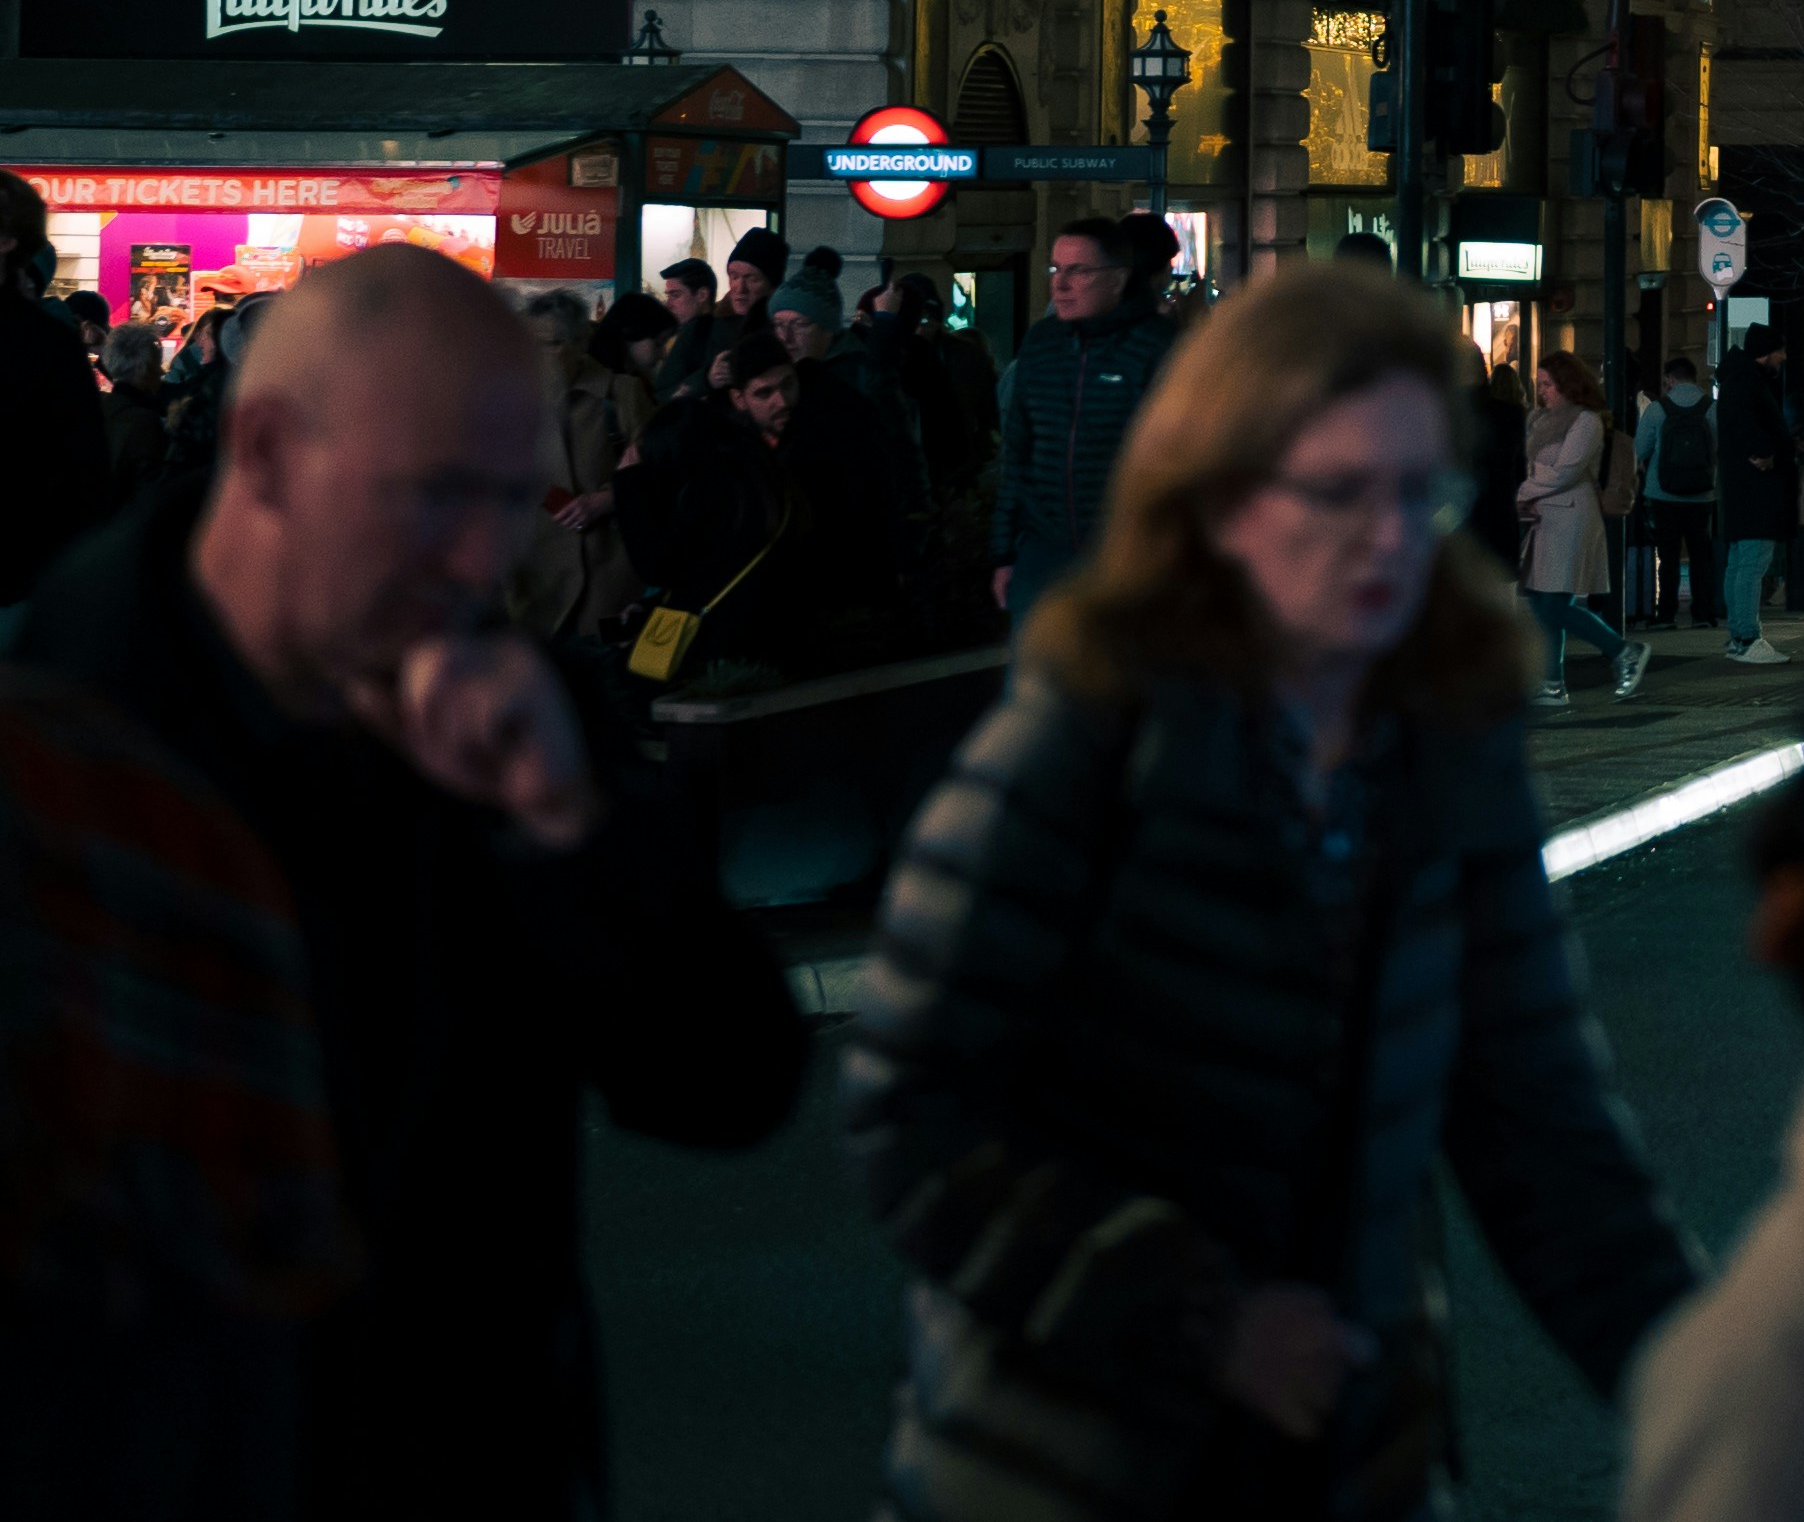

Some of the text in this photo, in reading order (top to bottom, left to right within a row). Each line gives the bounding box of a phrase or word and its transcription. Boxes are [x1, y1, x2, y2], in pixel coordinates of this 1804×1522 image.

[827, 154, 973, 172] UNDERGROUND
[1014, 158, 1118, 169] PUBLIC SUBWAY
[105, 178, 242, 205] TICKETS
[252, 179, 341, 207] HERE
[536, 237, 592, 260] TRAVEL
